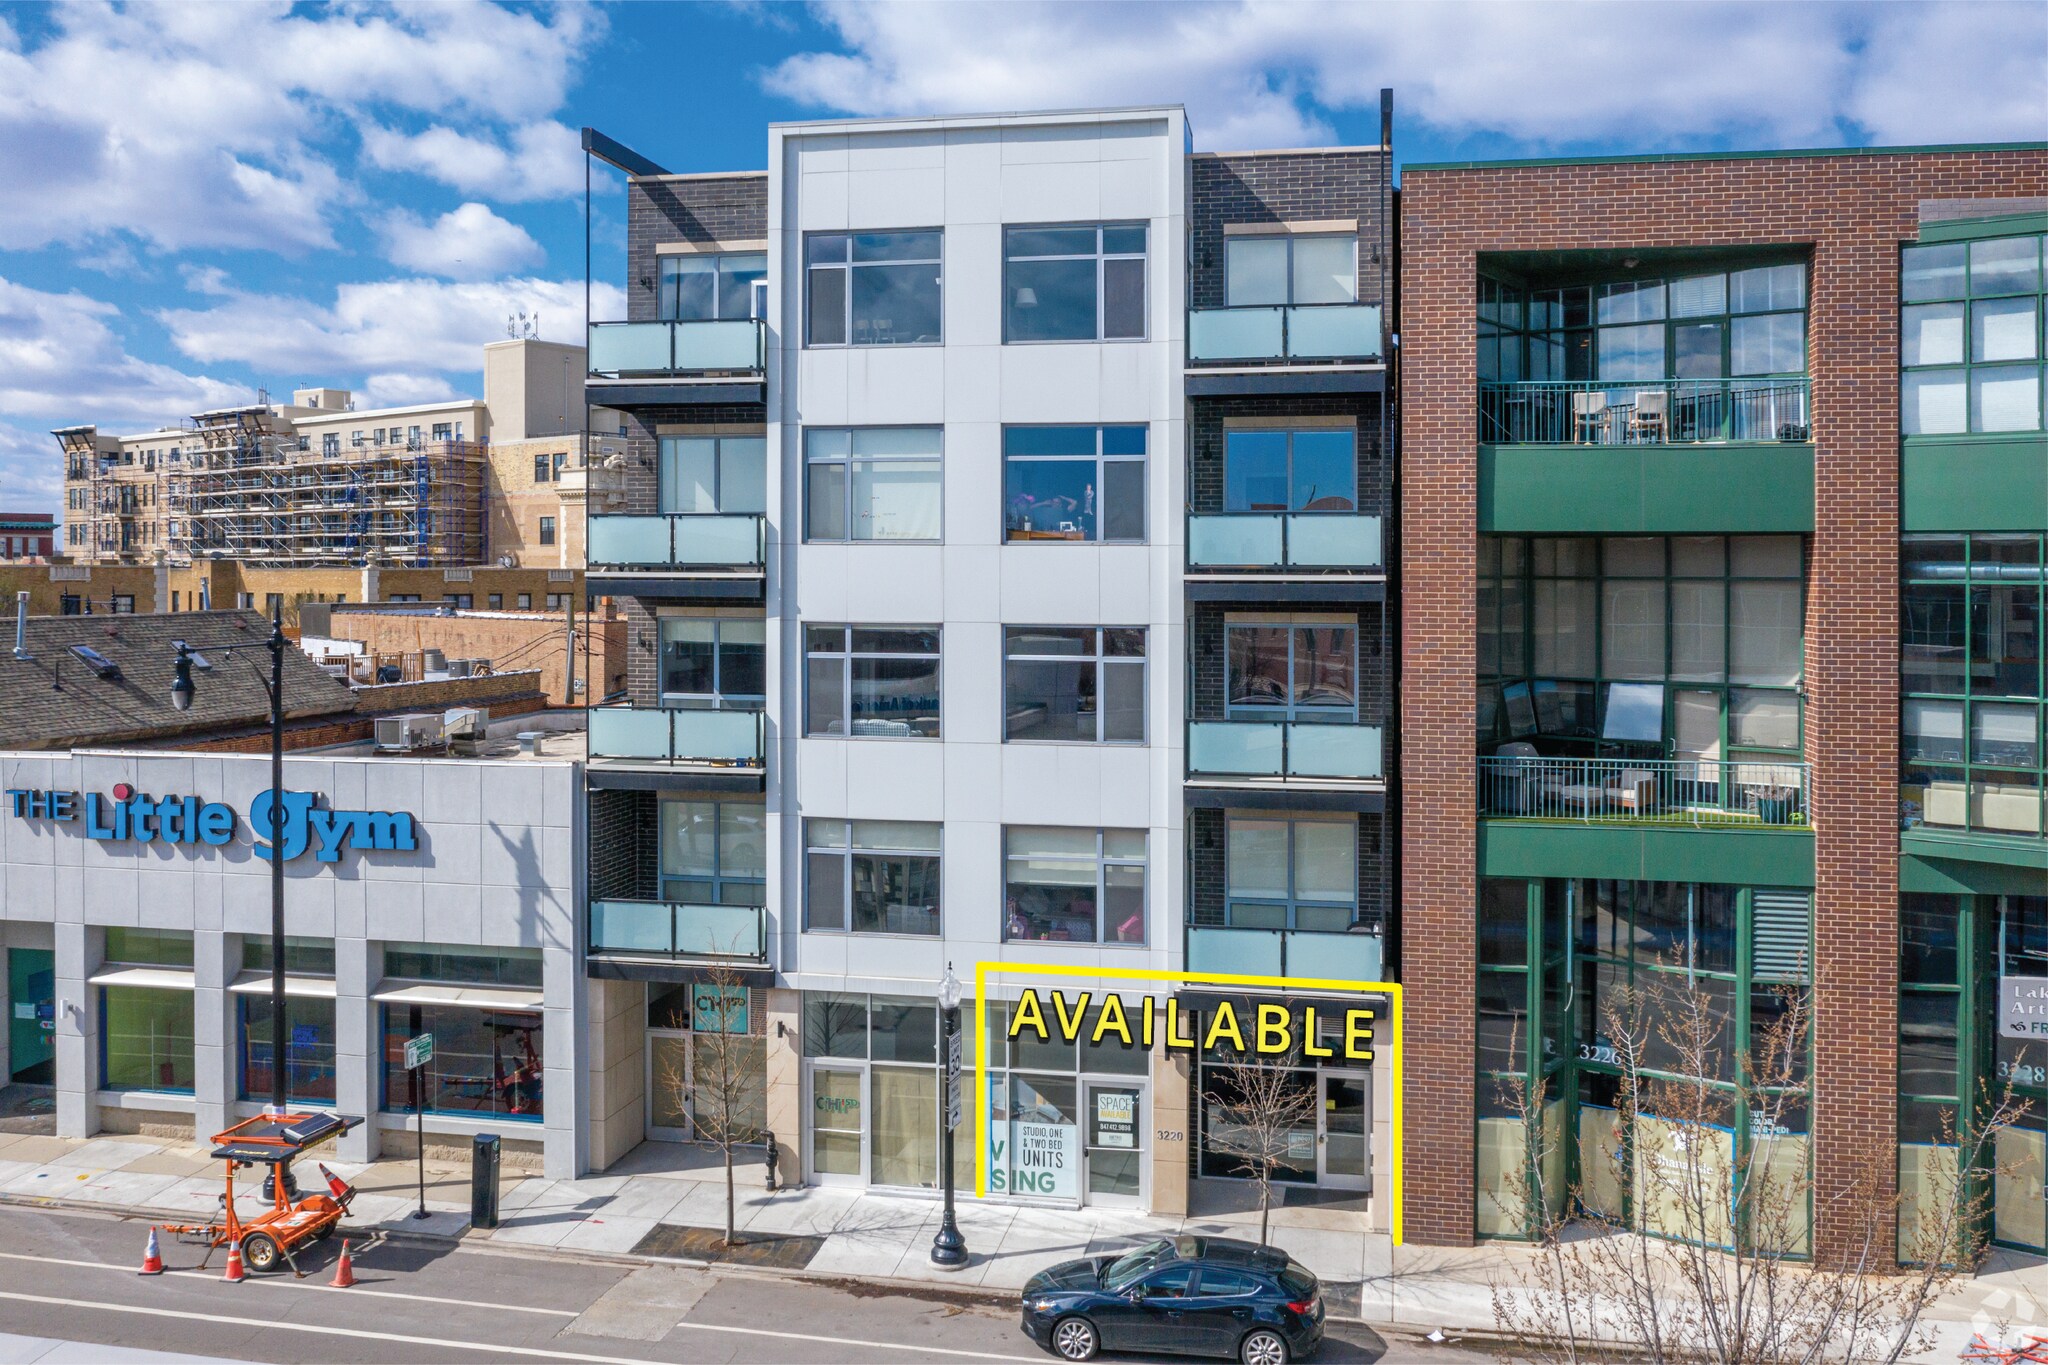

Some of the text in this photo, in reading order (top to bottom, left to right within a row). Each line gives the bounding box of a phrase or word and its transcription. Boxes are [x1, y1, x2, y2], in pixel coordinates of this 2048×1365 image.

[6, 783, 418, 863] THE Little gym
[1580, 1044, 1621, 1065] 3226
[950, 1054, 960, 1076] 30
[1998, 1061, 2046, 1082] 328
[1100, 1096, 1131, 1111] SPACE
[1100, 1110, 1131, 1120] AVAILABLE
[1023, 1126, 1063, 1139] STUDIO, ONE
[1157, 1130, 1183, 1141] 3220
[1023, 1138, 1063, 1150] & TWO BED
[1023, 1149, 1063, 1169] UNITS
